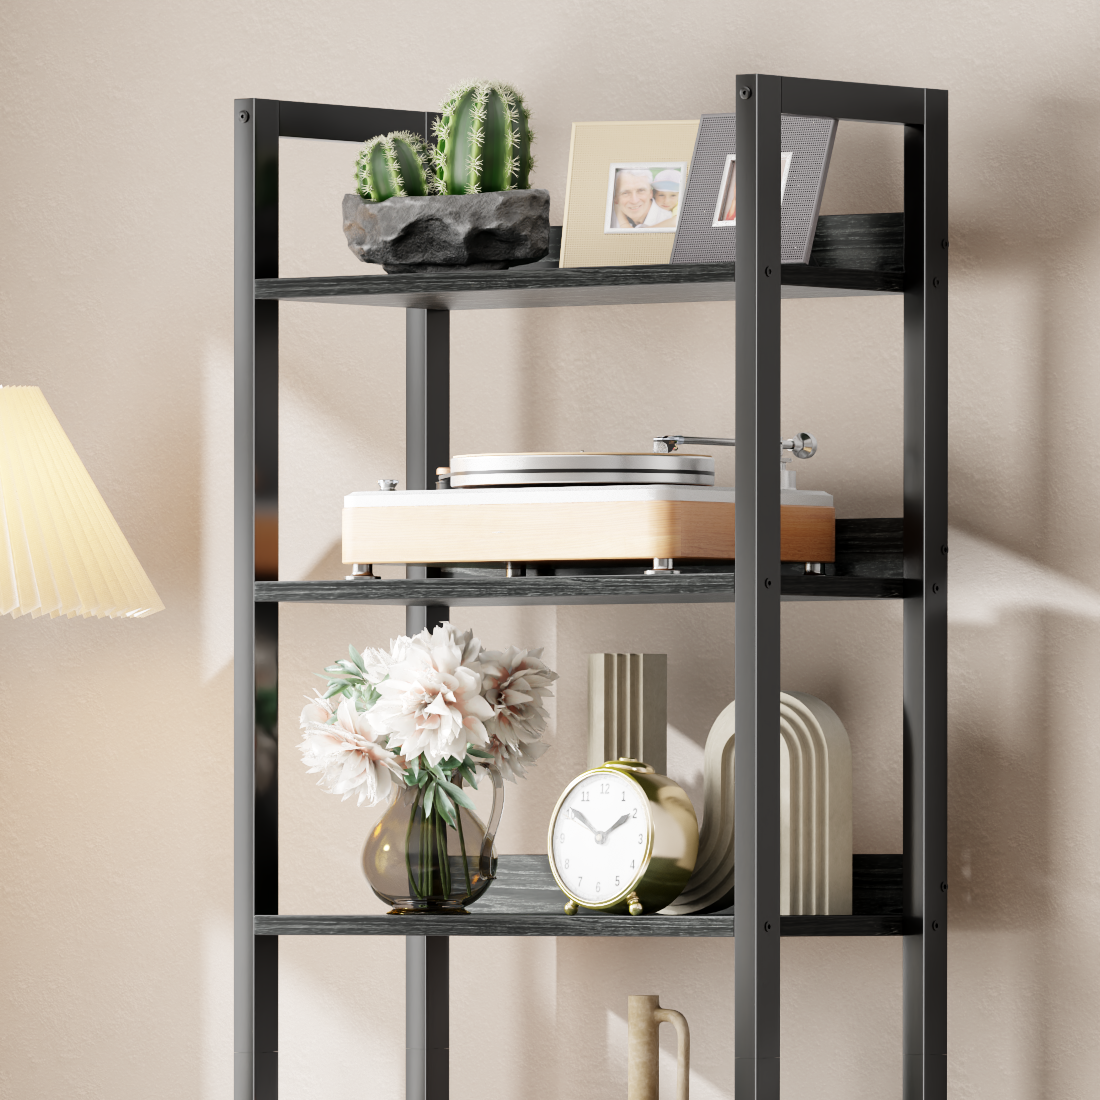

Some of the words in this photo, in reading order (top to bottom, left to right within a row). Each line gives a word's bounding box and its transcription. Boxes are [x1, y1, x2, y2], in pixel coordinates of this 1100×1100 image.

[599, 783, 611, 795] 12
[580, 791, 591, 802] 11
[620, 790, 626, 802] 1
[632, 808, 638, 819] 2
[559, 833, 566, 845] 9
[637, 833, 644, 845] 3
[564, 858, 570, 870] 8
[629, 859, 636, 870] 4
[577, 876, 584, 888] 7
[595, 881, 602, 893] 6
[614, 875, 621, 887] 5
